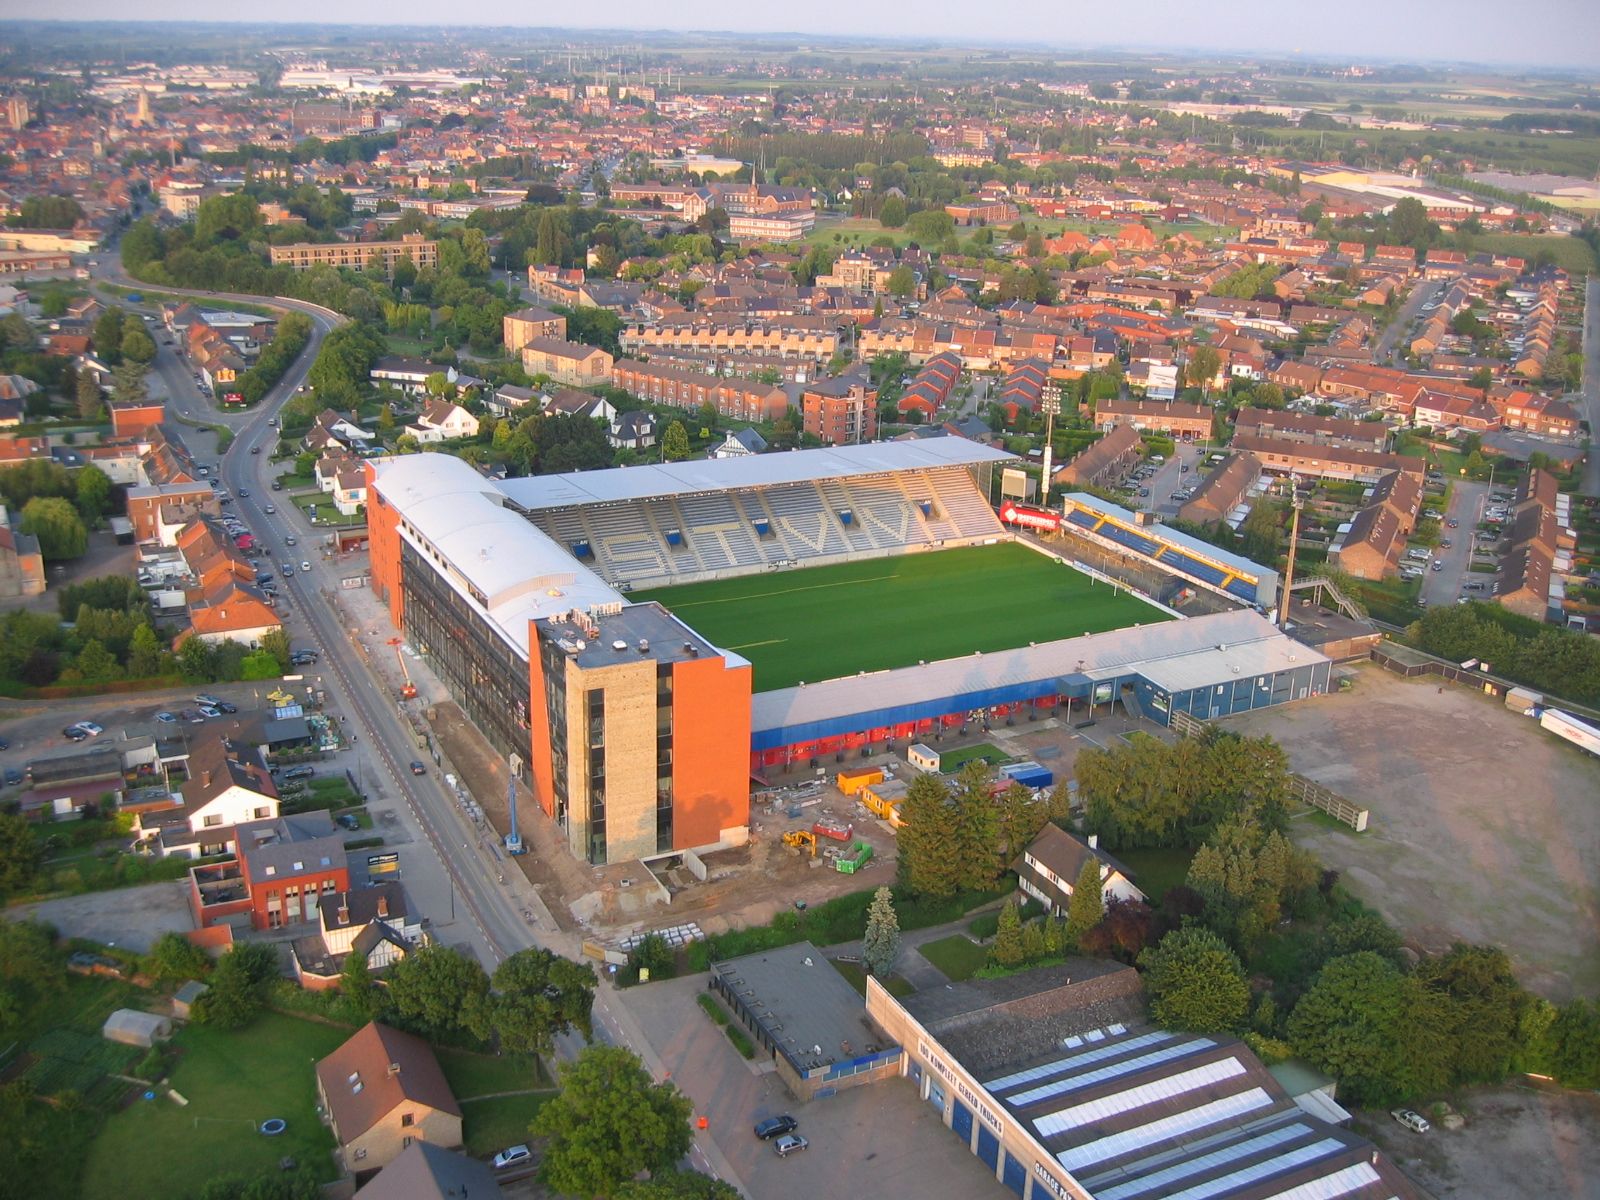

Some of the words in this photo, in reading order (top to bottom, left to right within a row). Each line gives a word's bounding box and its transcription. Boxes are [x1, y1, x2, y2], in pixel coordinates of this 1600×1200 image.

[930, 1054, 957, 1086] KOMPLEET
[958, 1082, 978, 1109] GEREED
[980, 1104, 1002, 1133] TRUCKS
[1035, 1162, 1060, 1194] GARAGE
